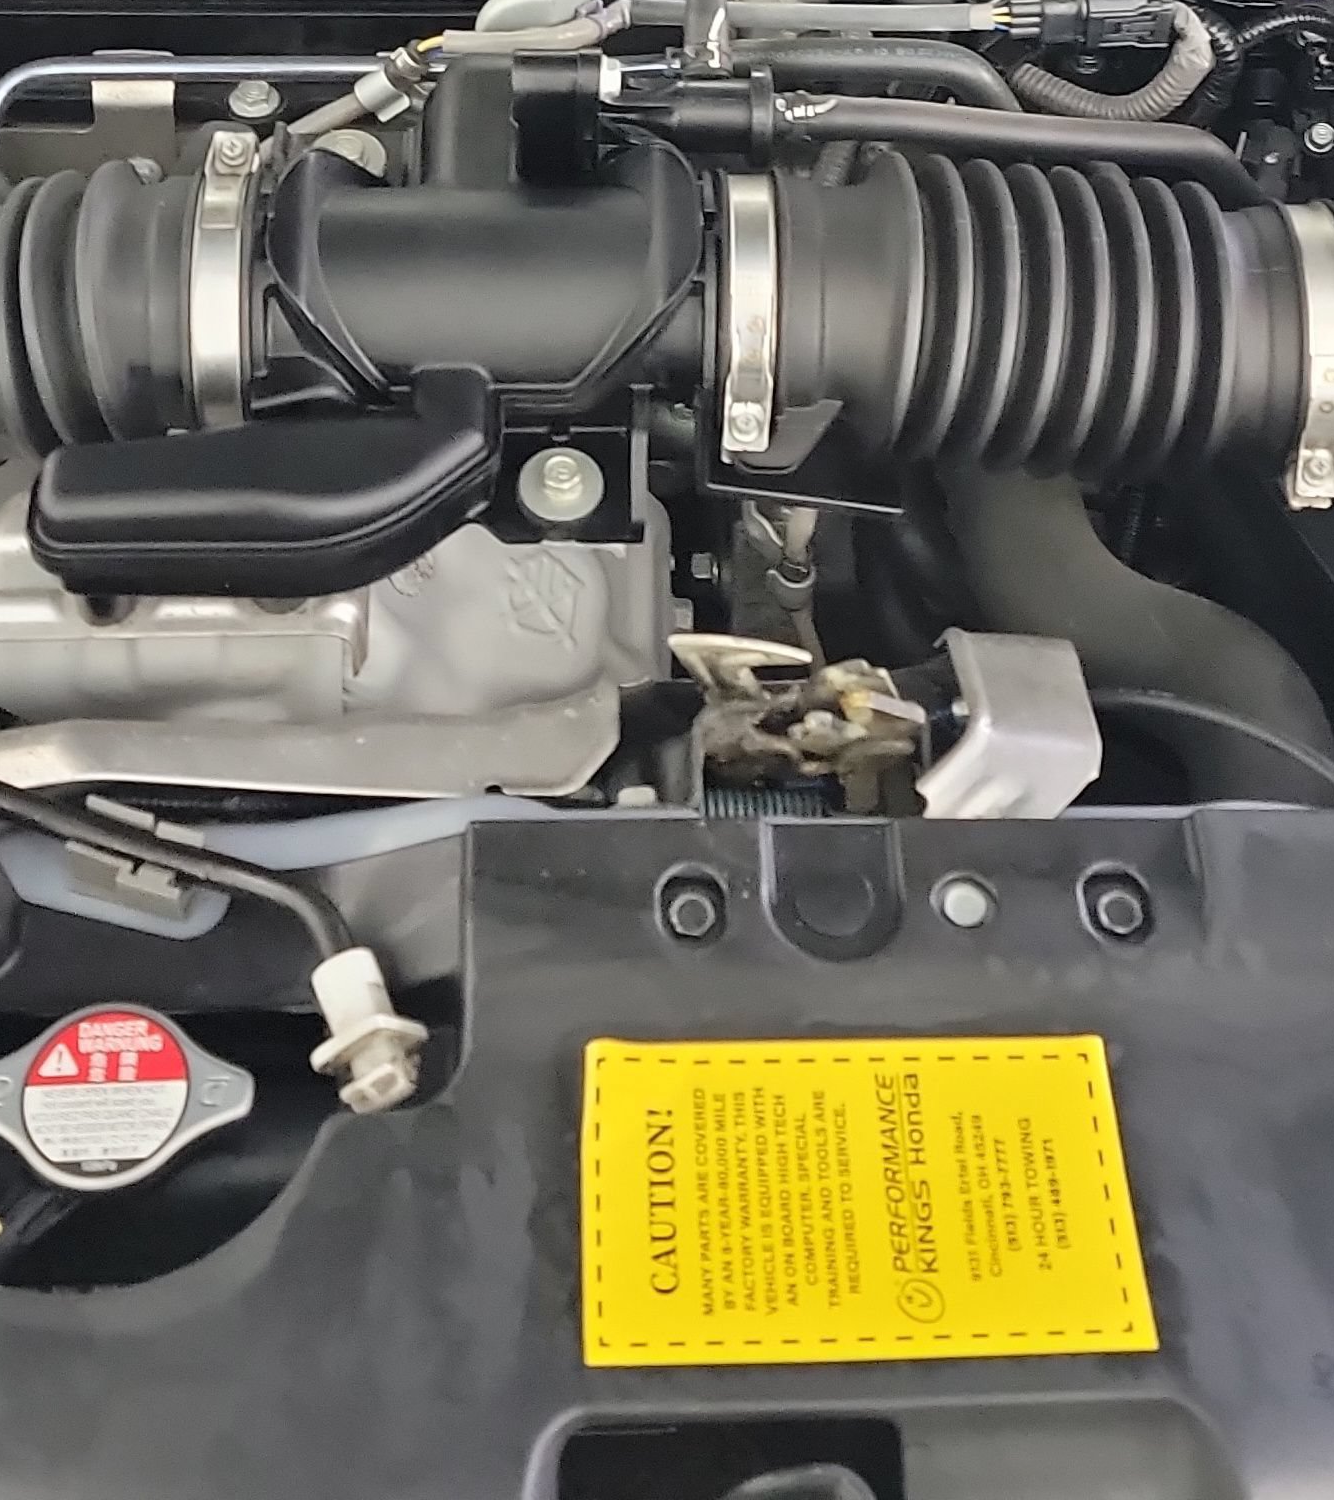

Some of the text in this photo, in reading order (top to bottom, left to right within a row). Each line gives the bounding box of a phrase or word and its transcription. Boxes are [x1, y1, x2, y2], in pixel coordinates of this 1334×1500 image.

[77, 1034, 165, 1054] WARNING
[78, 1020, 149, 1038] DANGER
[713, 1092, 727, 1132] MILE
[733, 1091, 746, 1126] THIS
[948, 1110, 968, 1154] Road,
[793, 1112, 810, 1182] SPECIAL
[874, 1072, 913, 1274] PERFORMANCE
[900, 1072, 939, 1273] KINGS Honda
[976, 1166, 991, 1189] OH
[645, 1107, 680, 1295] CAUTION!
[692, 1087, 715, 1316] MANY PARTS ARE COVERED
[752, 1087, 778, 1316] VEHICLE IS EQUIPPED WITH
[772, 1093, 798, 1306] AN ON BOARD HIGH TECH
[811, 1090, 841, 1308] TRAINING AND TOOLS ARE
[832, 1102, 862, 1294] REQUIRED TO SERVICE.
[1016, 1117, 1051, 1270] 24 HOUR TOWING
[721, 1259, 734, 1283] AN
[723, 1289, 736, 1309] BY
[741, 1234, 757, 1310] FACTORY
